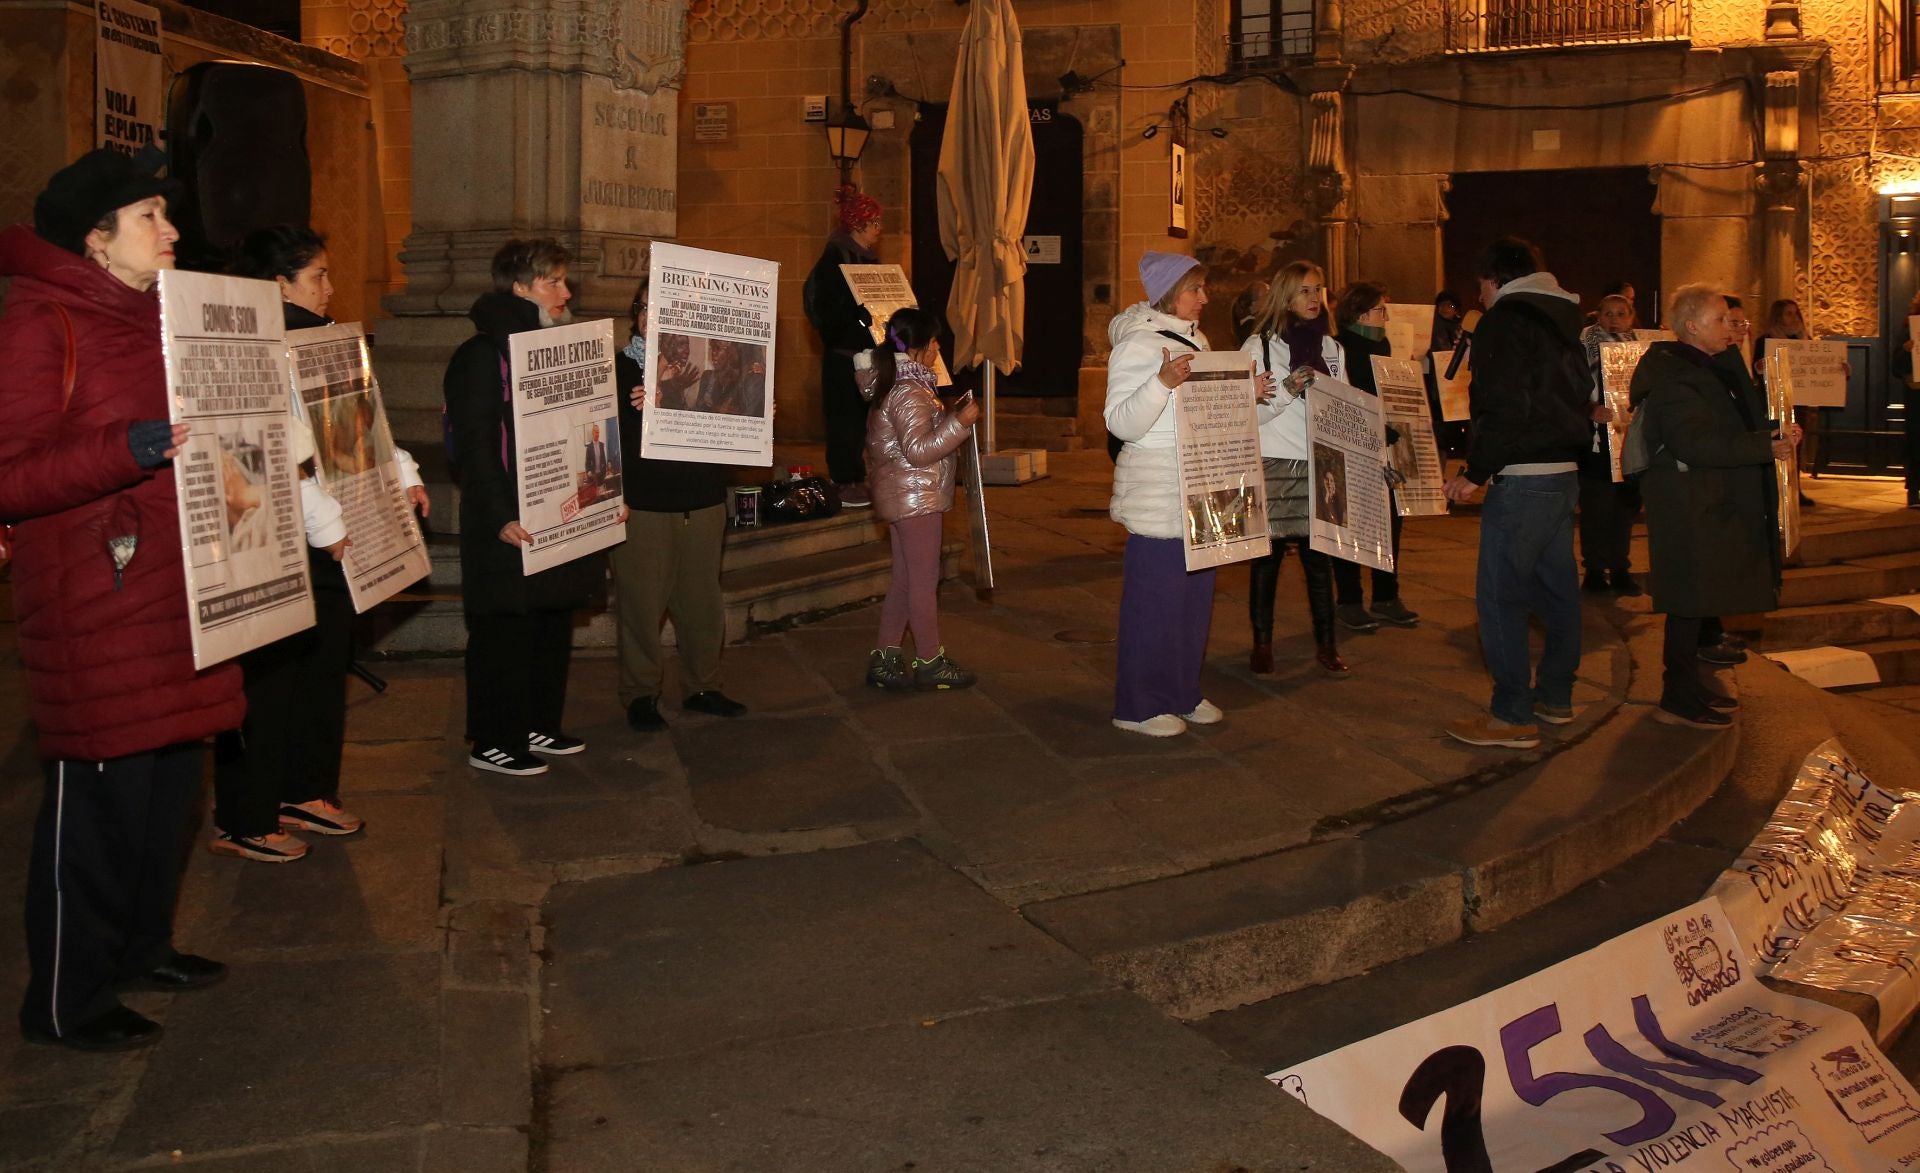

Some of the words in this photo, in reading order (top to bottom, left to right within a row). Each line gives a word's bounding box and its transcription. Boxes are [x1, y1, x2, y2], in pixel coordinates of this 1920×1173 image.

[662, 271, 729, 293] BREAKING
[732, 282, 769, 298] NEWS
[202, 302, 236, 332] COMING
[235, 305, 258, 333] SOON
[671, 299, 679, 309] UN
[680, 301, 700, 311] MUNDO
[701, 304, 707, 312] EN
[731, 308, 750, 318] CONTRA
[751, 311, 760, 320] LAS
[688, 311, 694, 319] LA
[729, 316, 735, 325] DE
[736, 317, 763, 329] FALLECIDAS
[764, 321, 770, 329] EN
[658, 315, 689, 327] CONFLICTOS
[690, 320, 716, 331] ARMADOS
[717, 323, 723, 332] SE
[724, 324, 744, 335] DUPLICA
[745, 327, 751, 335] EN
[752, 328, 759, 337] UN
[526, 344, 566, 372] EXTRA!!
[567, 337, 604, 363] EXTRA!!
[518, 378, 541, 391] DETENIDO
[541, 377, 547, 386] EL
[548, 373, 567, 385] ALCALDE
[568, 371, 574, 381] DE
[526, 389, 532, 399] DE
[533, 385, 553, 397] SEGOVIA
[553, 383, 562, 393] POR
[586, 377, 592, 386] SU
[593, 374, 607, 385] MUJER
[1331, 398, 1362, 417] NEVENKA
[1313, 414, 1345, 433] SOCIEDAD
[1369, 428, 1377, 437] LA
[1398, 994, 1765, 1173] 25N
[1627, 1120, 1722, 1173] VIOLENCIA
[1717, 1086, 1802, 1137] MACHISTA
